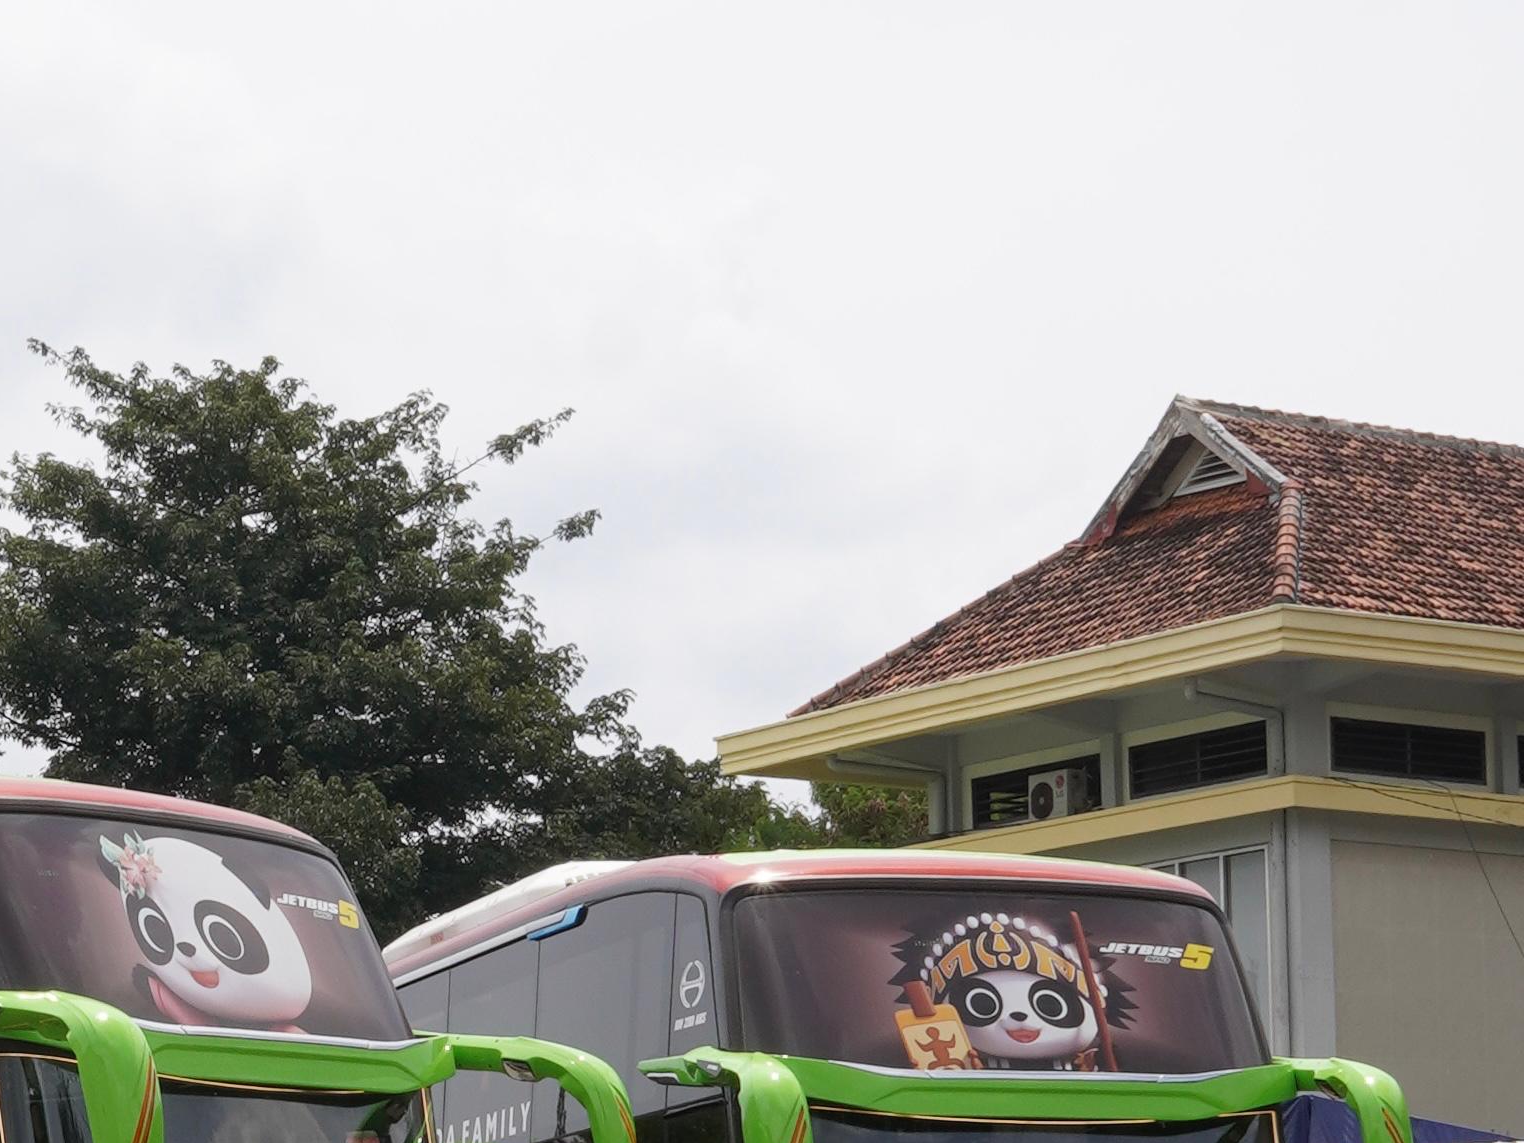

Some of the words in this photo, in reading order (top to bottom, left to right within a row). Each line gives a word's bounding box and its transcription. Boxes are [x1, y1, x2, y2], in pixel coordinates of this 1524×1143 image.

[276, 893, 339, 915] JETBUS
[337, 899, 360, 929] 5
[1098, 942, 1184, 959] JETBUS
[1179, 943, 1215, 970] 5
